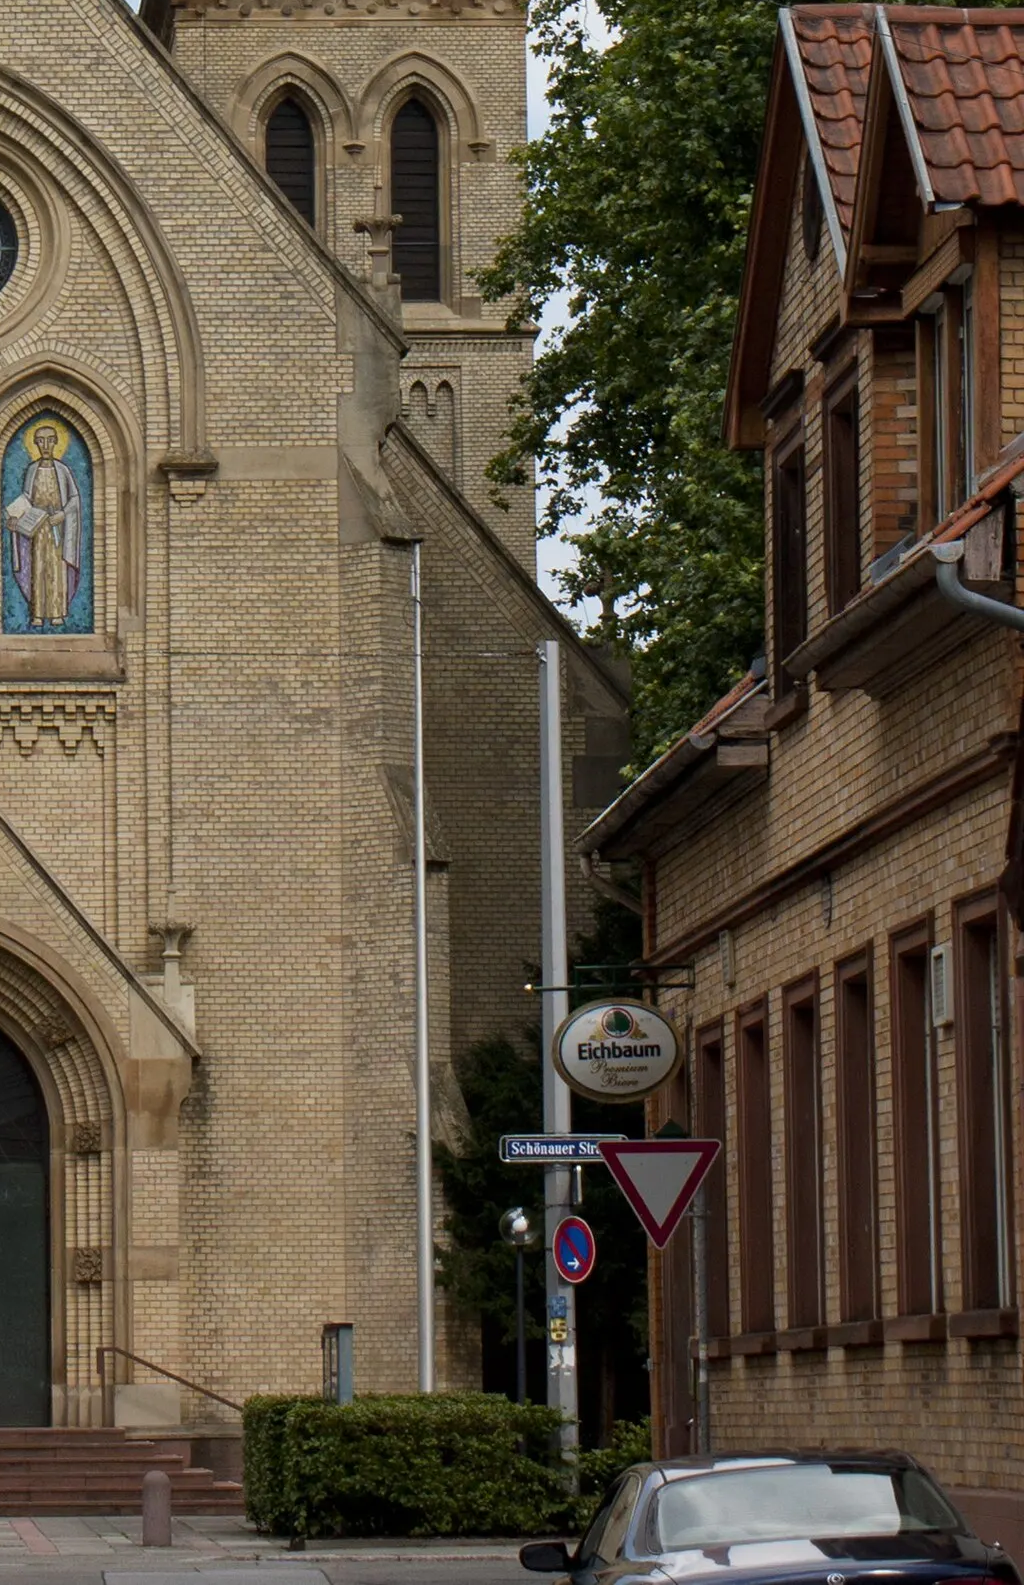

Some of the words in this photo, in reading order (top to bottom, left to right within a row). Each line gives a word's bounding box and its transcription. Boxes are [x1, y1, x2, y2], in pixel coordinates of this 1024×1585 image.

[578, 1041, 661, 1061] Eichbaum
[590, 1059, 649, 1074] Premium
[511, 1141, 575, 1155] Schönauer
